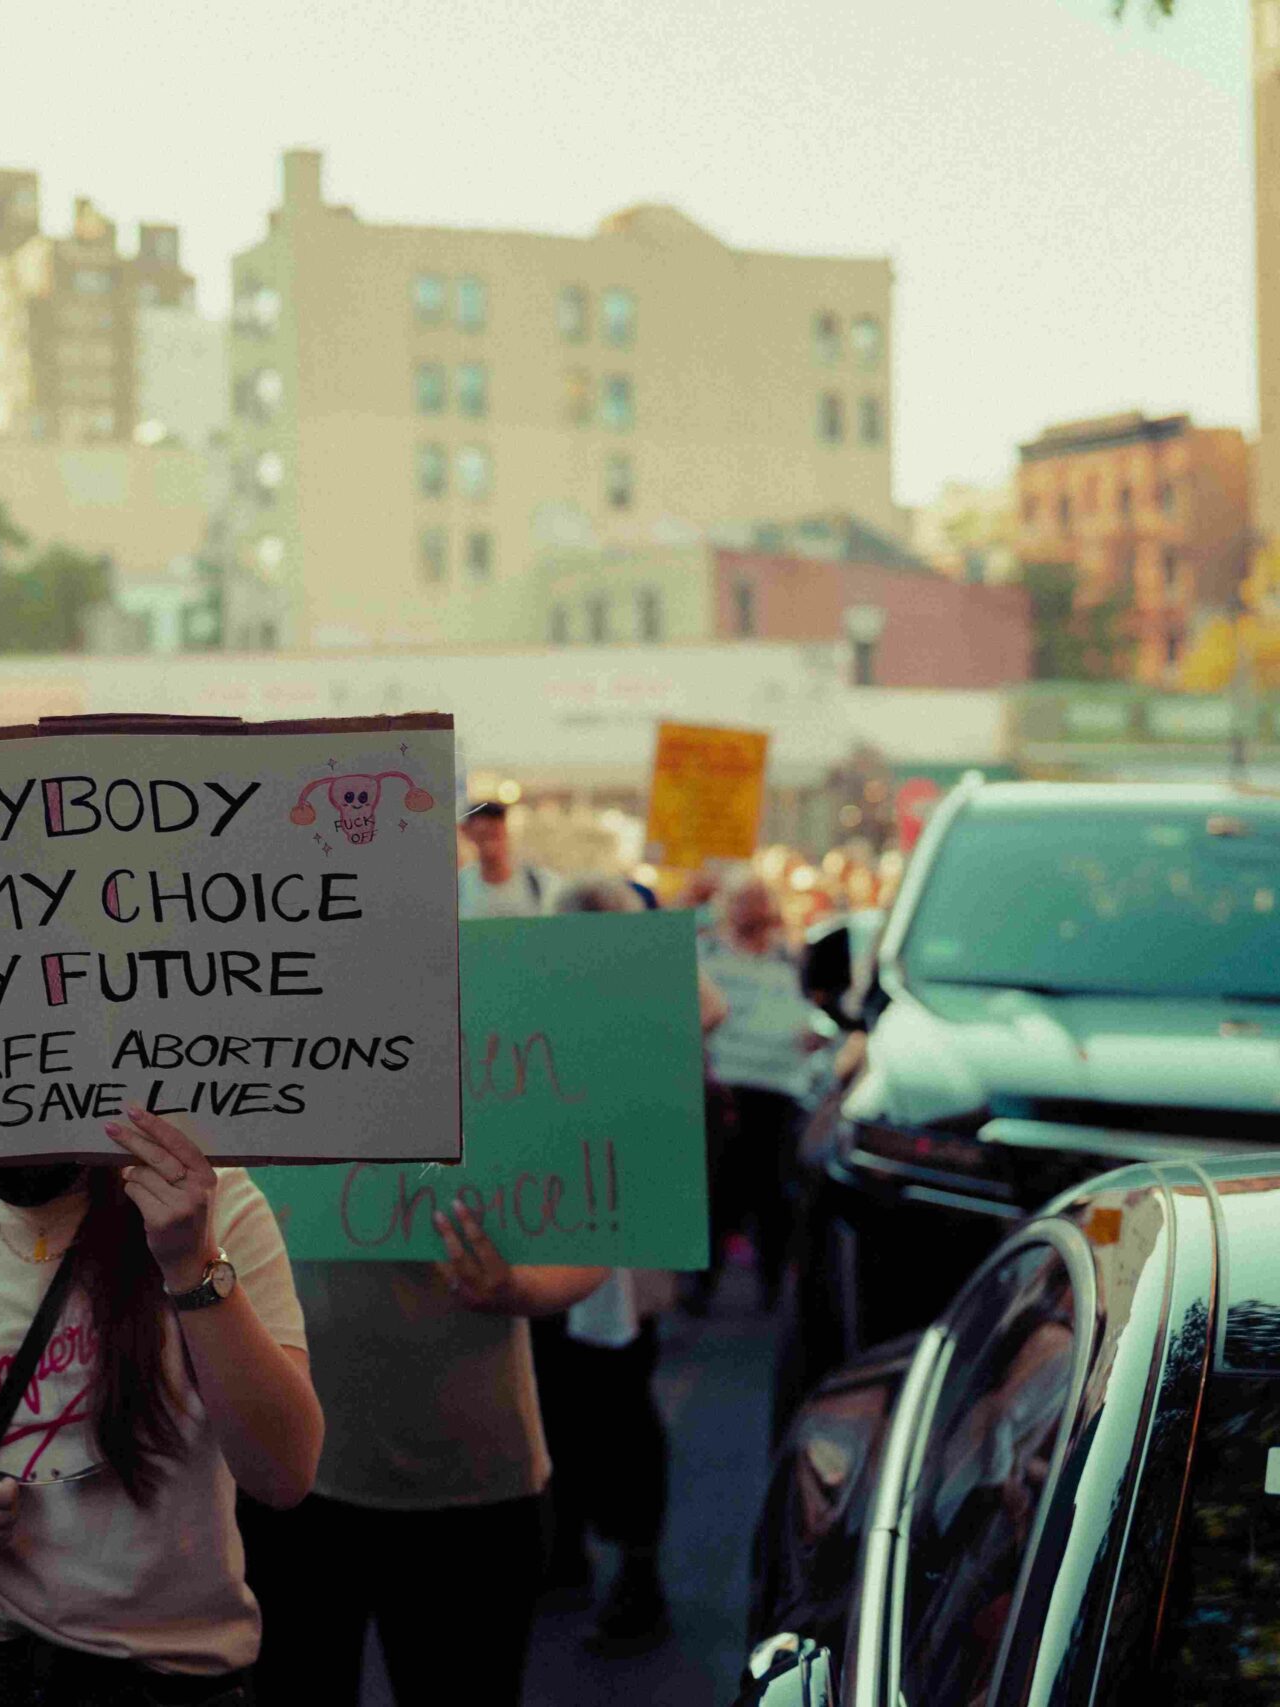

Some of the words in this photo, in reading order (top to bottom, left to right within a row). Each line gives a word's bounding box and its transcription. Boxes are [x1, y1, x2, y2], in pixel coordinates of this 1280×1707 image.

[334, 814, 376, 832] FUCK
[351, 829, 379, 843] OFF
[101, 869, 363, 923] CHOICE
[40, 950, 324, 1007] FUTURE
[112, 1029, 416, 1073] ABORTIONS
[146, 1080, 307, 1118] LIVES
